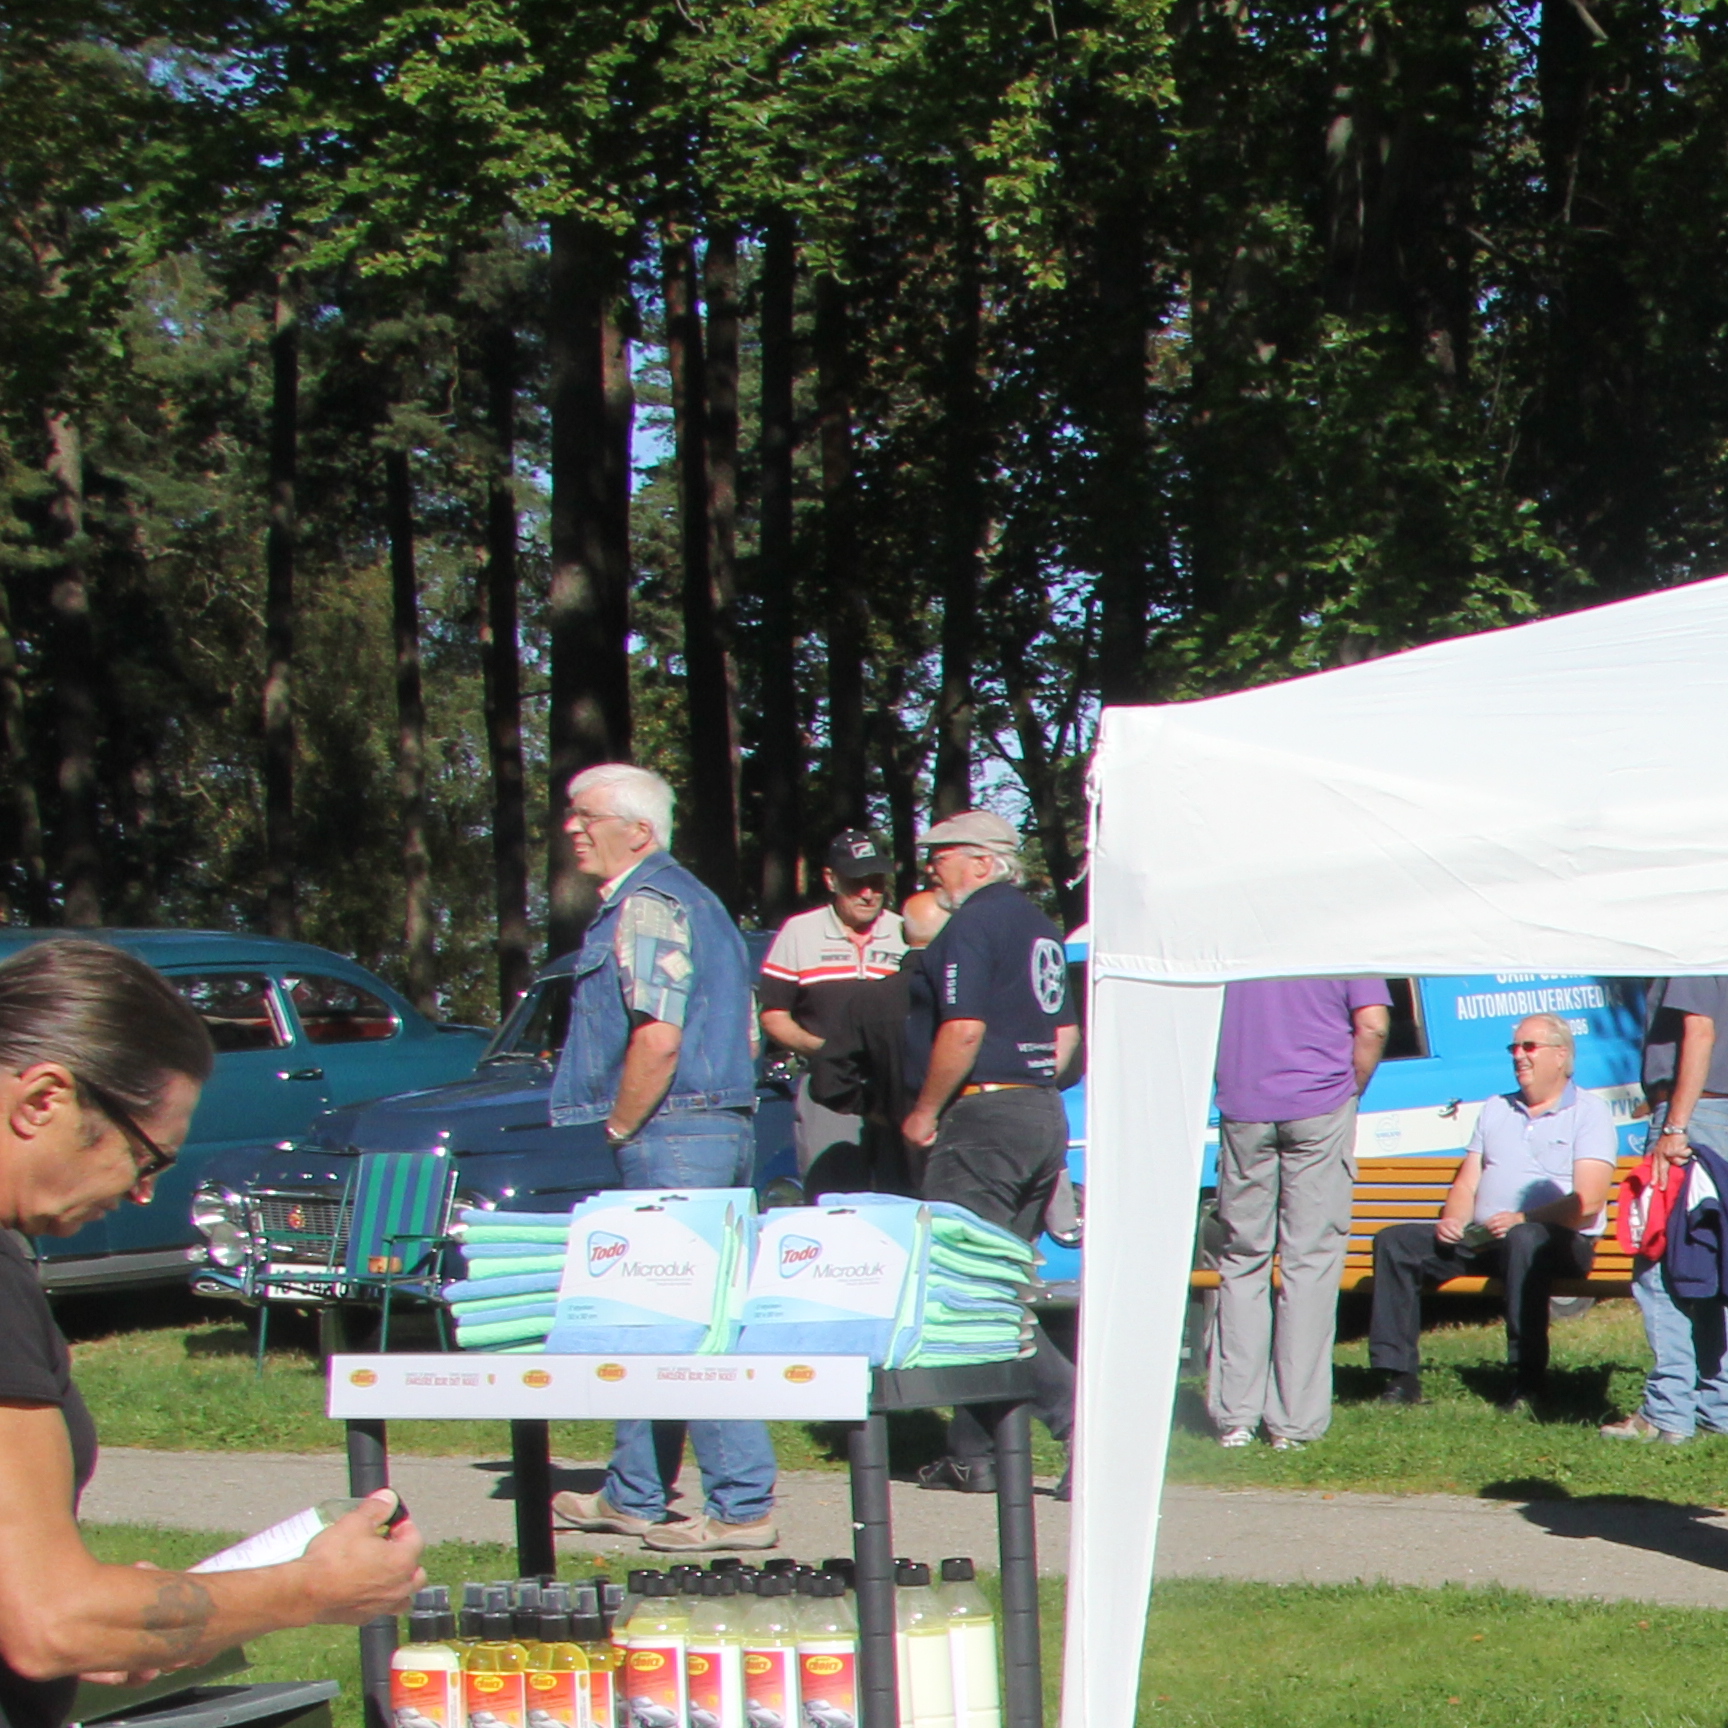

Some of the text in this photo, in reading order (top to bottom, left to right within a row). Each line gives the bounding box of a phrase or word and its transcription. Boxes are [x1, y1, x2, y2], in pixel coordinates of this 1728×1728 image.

[1457, 984, 1605, 1021] AUTOMOBILVERKSTED
[591, 1242, 626, 1262] Todo
[782, 1246, 819, 1264] Todo
[622, 1262, 695, 1278] Microduk
[813, 1263, 885, 1279] Microduk
